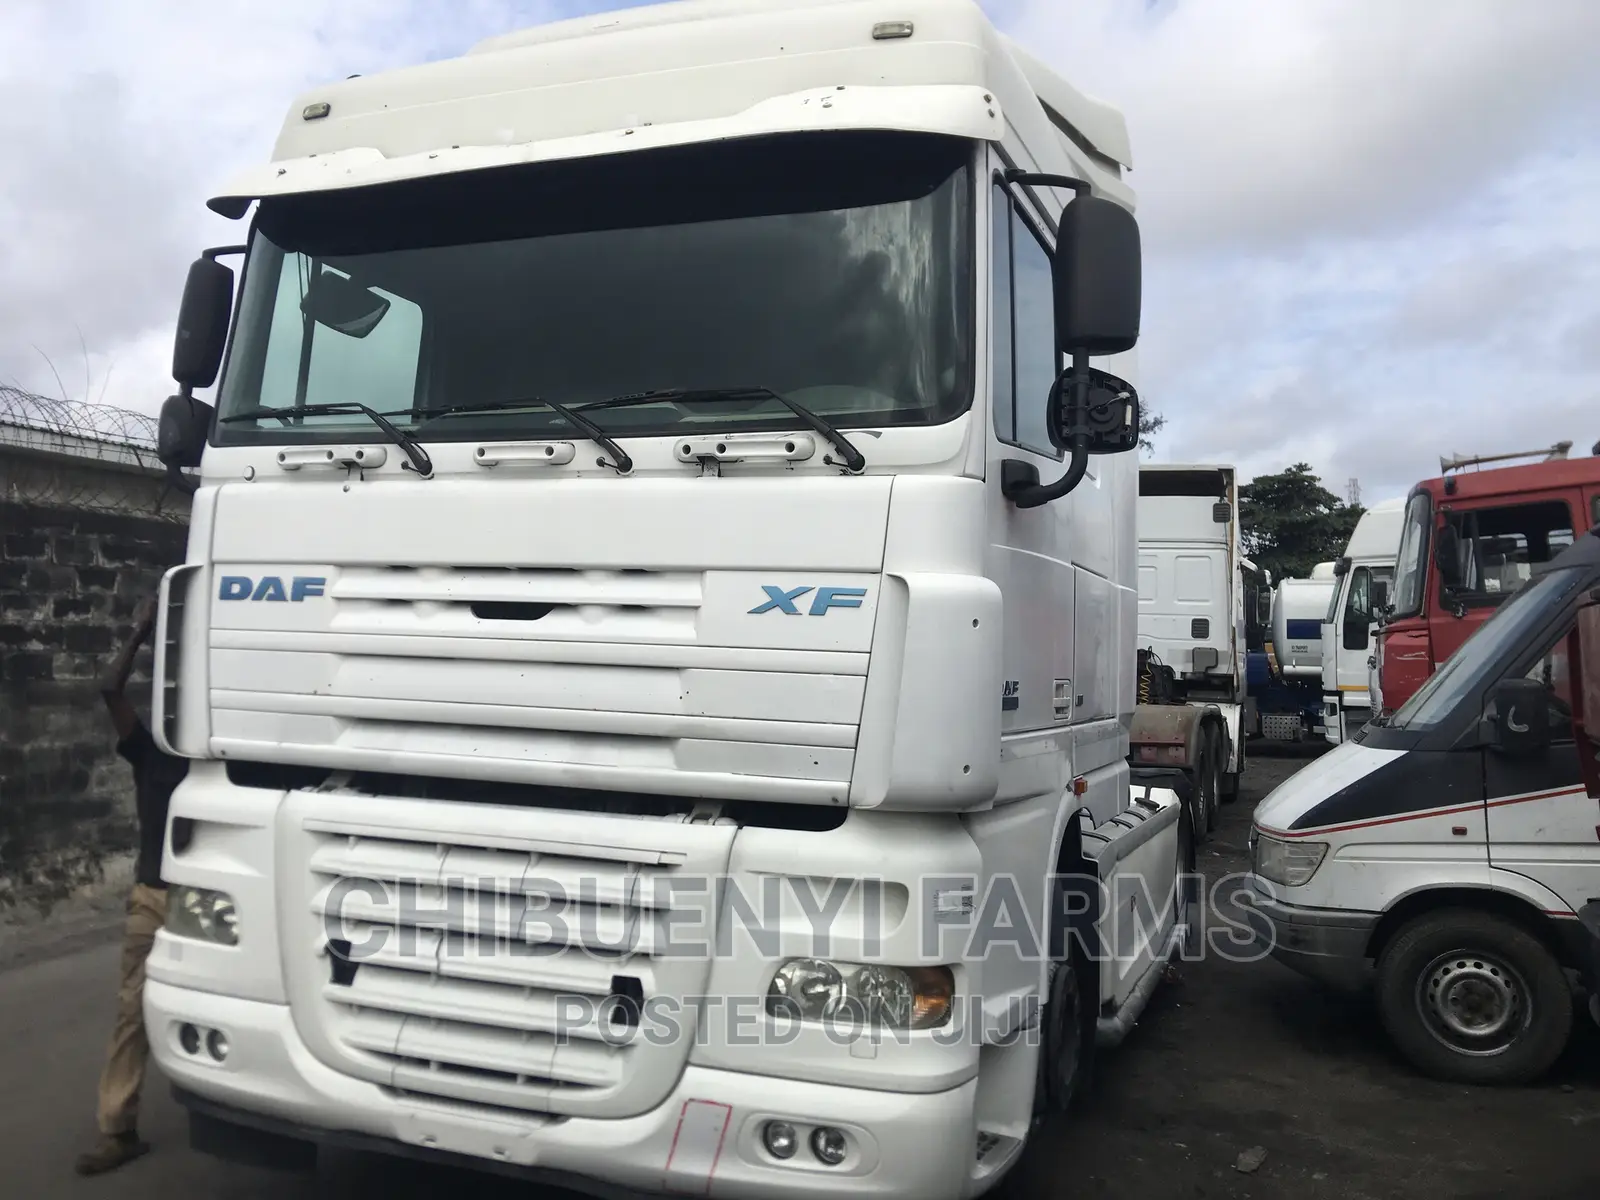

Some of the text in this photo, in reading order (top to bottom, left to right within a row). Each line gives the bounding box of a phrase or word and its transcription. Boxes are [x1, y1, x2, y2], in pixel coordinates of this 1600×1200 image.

[218, 575, 327, 602] DAF
[746, 585, 868, 616] XF
[1001, 680, 1020, 697] AF
